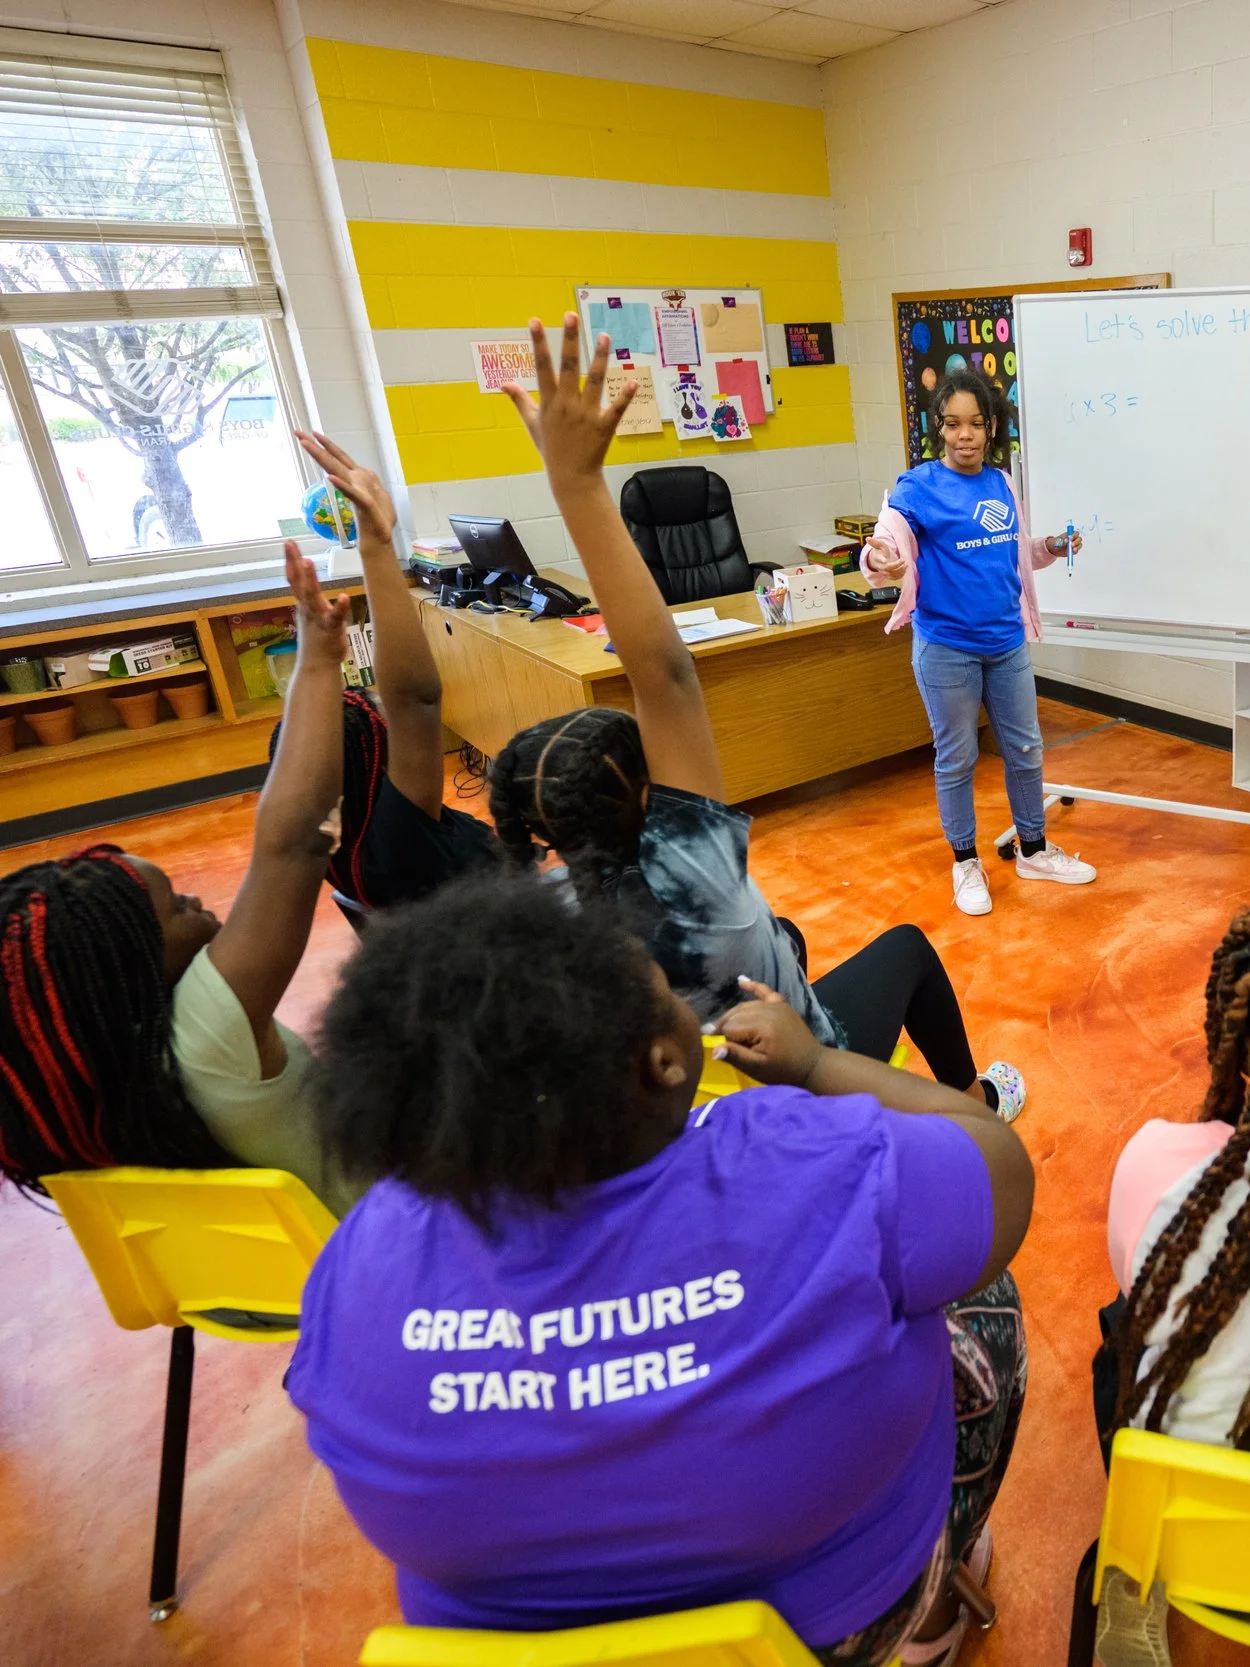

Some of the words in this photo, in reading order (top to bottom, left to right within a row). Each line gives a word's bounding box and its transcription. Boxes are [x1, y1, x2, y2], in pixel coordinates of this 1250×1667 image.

[943, 317, 1015, 344] WELCO
[1084, 310, 1145, 343] Let's
[1156, 309, 1218, 343] solve
[478, 344, 498, 354] MAKE
[499, 344, 520, 354] TODAY
[520, 344, 529, 353] SO
[483, 369, 519, 379] YESTERDAY
[956, 538, 982, 550] BOYS
[982, 537, 991, 546] &
[529, 1269, 745, 1355] FUTURES
[428, 1369, 557, 1414] START
[568, 1342, 711, 1411] HERE.
